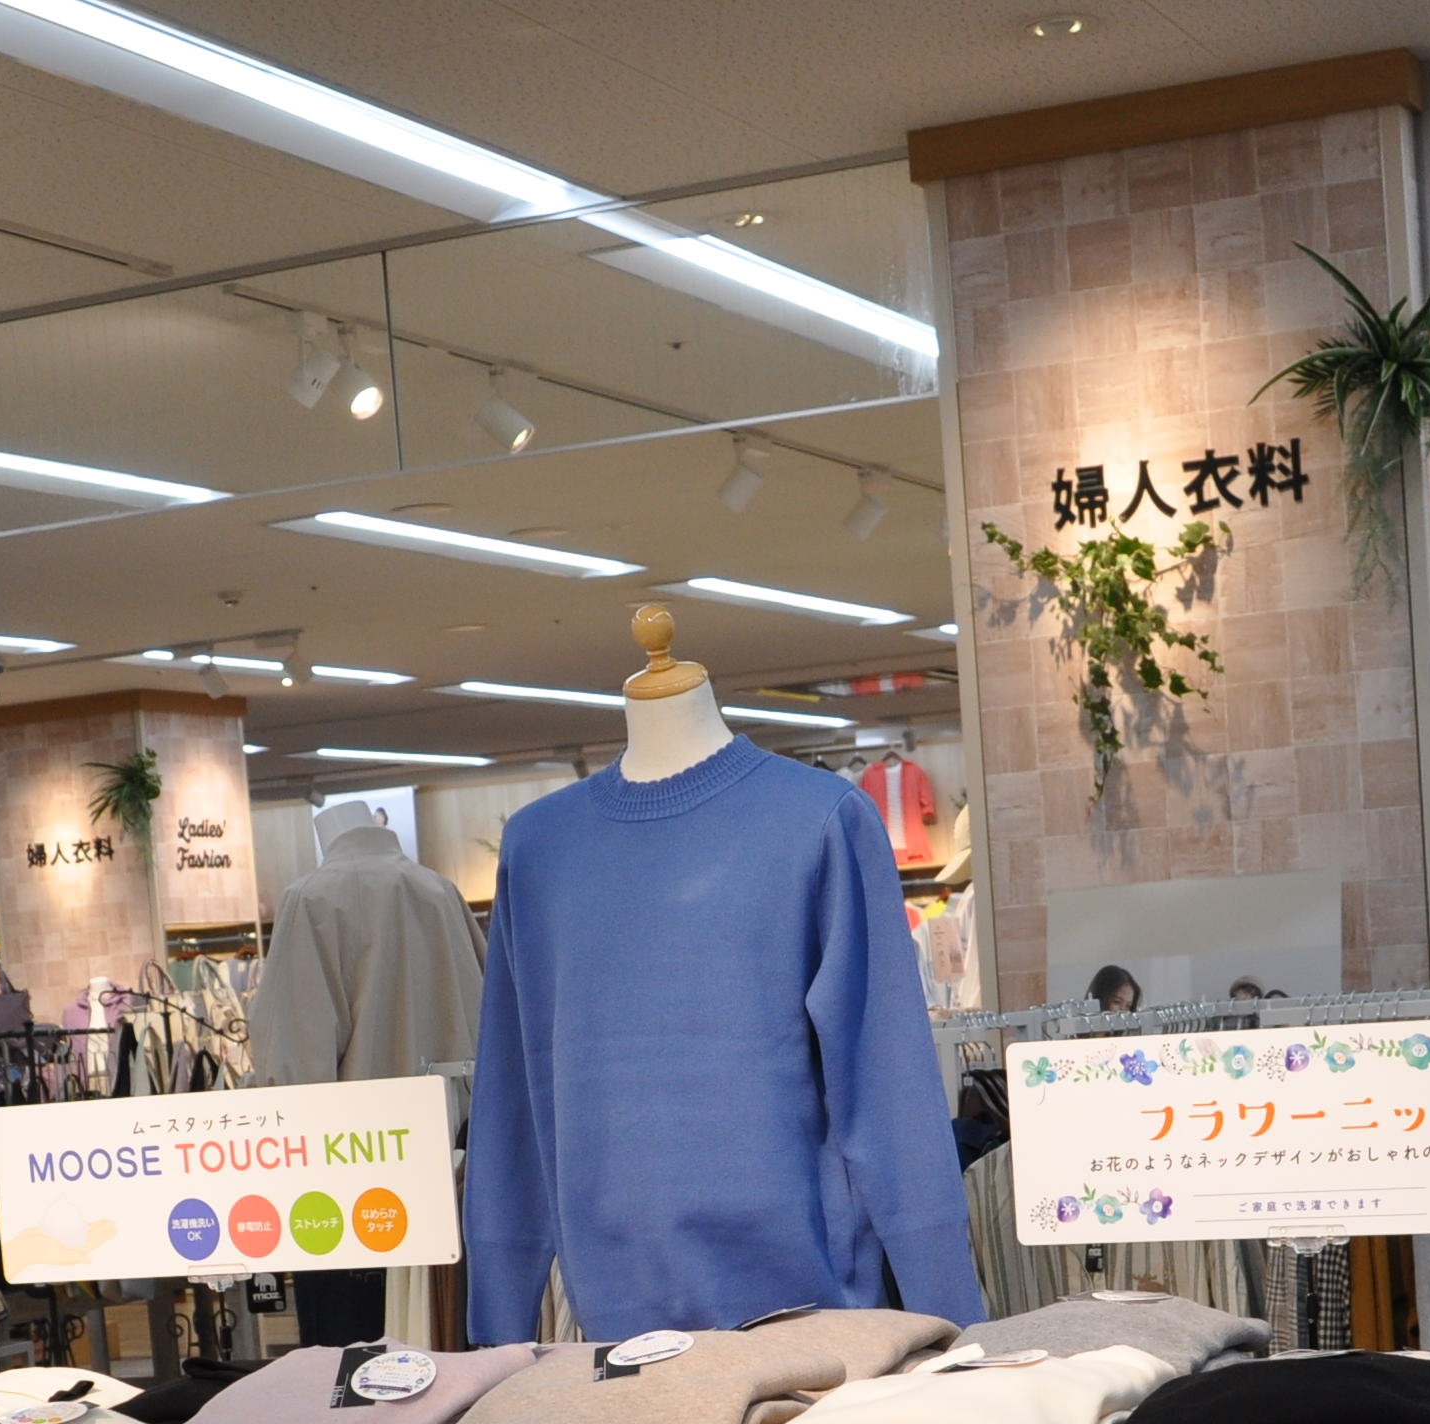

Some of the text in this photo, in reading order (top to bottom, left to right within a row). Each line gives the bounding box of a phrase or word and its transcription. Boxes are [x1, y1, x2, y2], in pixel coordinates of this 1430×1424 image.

[1051, 438, 1309, 531] 婦人衣料
[178, 817, 226, 842] Ladies'
[27, 836, 115, 868] 婦人衣料
[176, 847, 231, 872] Fashion
[133, 1110, 286, 1135] ムースタッチニット
[28, 1128, 410, 1183] MOOSE TOUCH KNIT
[294, 1217, 340, 1230] ストレッチ
[360, 1208, 399, 1220] なめらか
[366, 1220, 395, 1233] タッチ
[186, 1230, 203, 1242] OK
